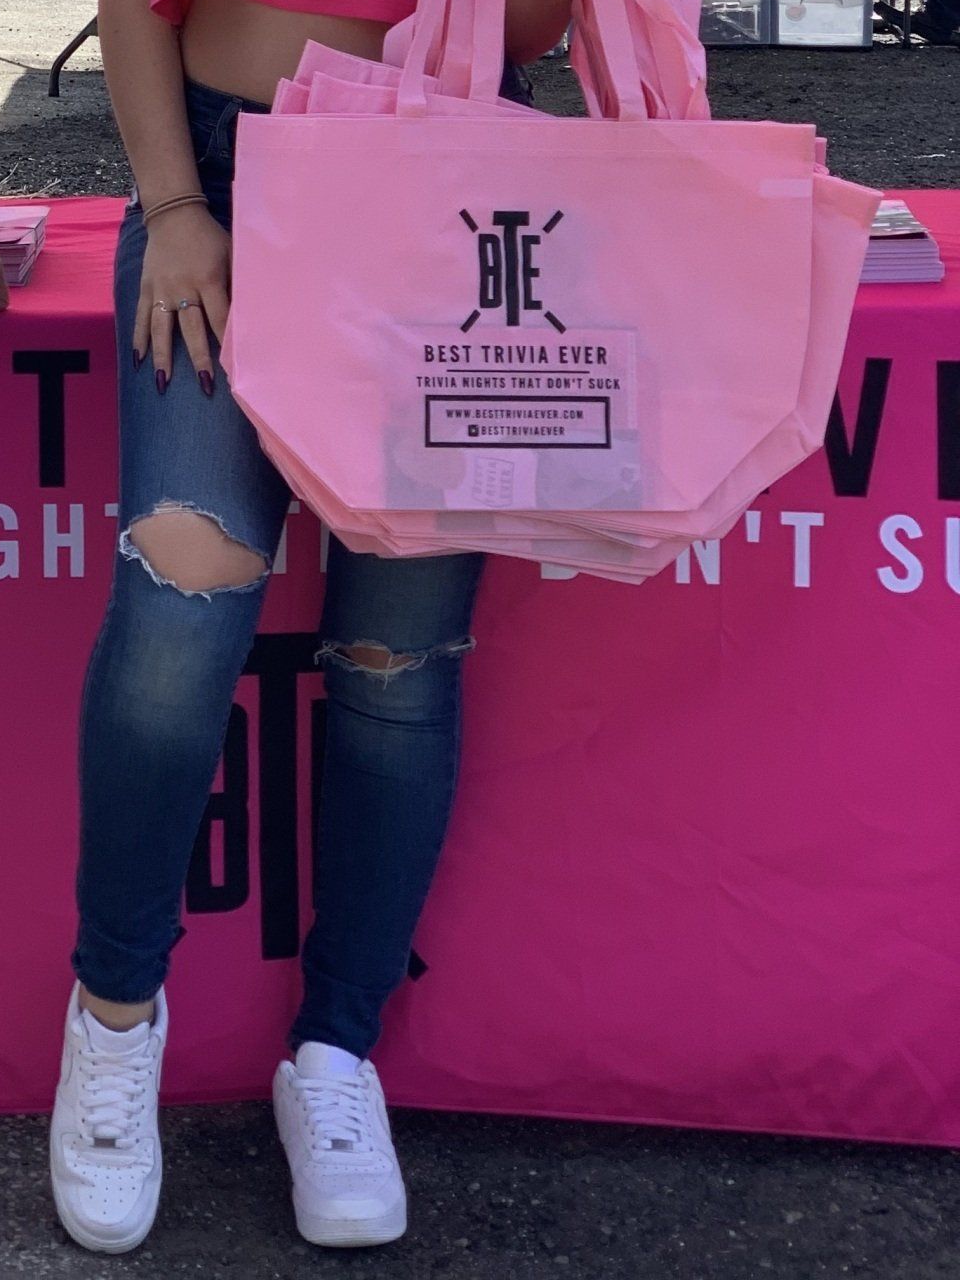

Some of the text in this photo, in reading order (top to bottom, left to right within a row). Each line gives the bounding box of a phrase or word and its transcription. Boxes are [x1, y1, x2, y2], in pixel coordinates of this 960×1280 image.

[478, 211, 542, 326] BTE
[424, 345, 608, 365] BEST TRIVIA EVER
[416, 376, 621, 390] TRIVIA NIGHTS THAT DON'T SUCK
[446, 409, 583, 420] WWW.BESTTRIVIAEVER.COM
[481, 426, 565, 436] BESTTRIVIAEVER
